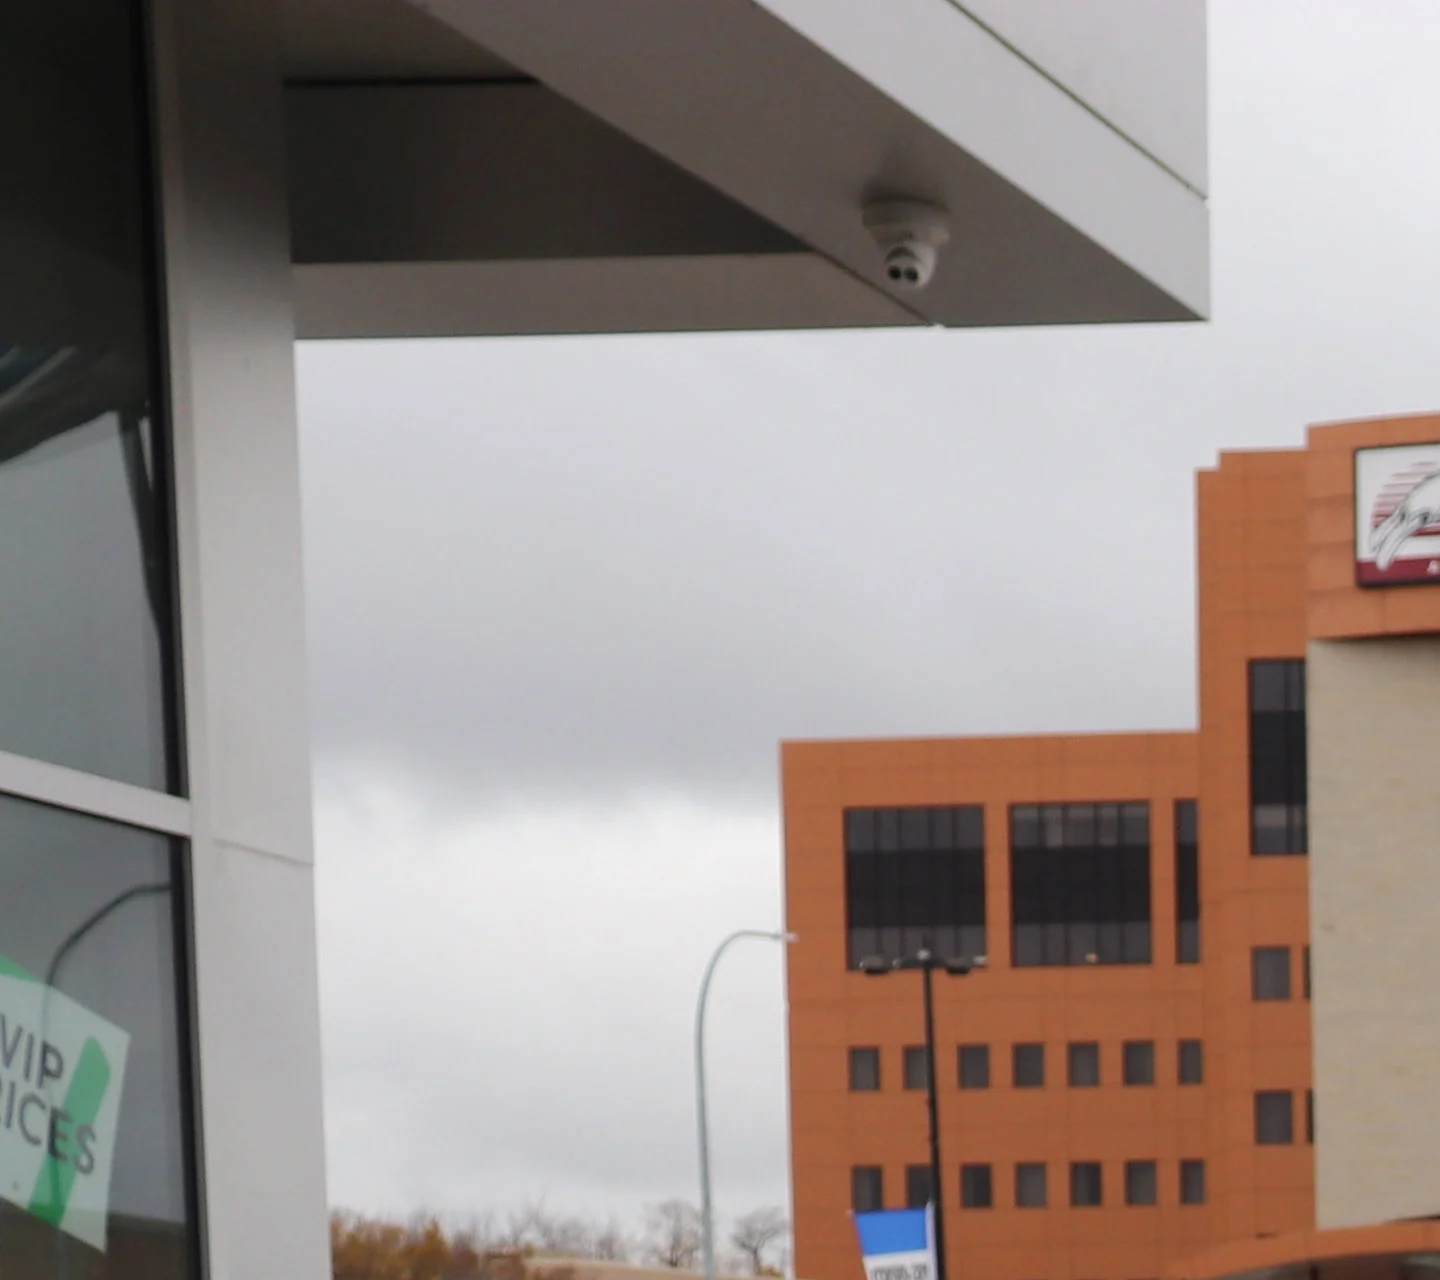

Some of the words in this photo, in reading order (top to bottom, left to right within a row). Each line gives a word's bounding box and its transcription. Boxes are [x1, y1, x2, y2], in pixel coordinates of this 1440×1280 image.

[1427, 561, 1438, 574] A
[0, 1013, 65, 1089] VIP
[0, 1080, 97, 1176] ICES
